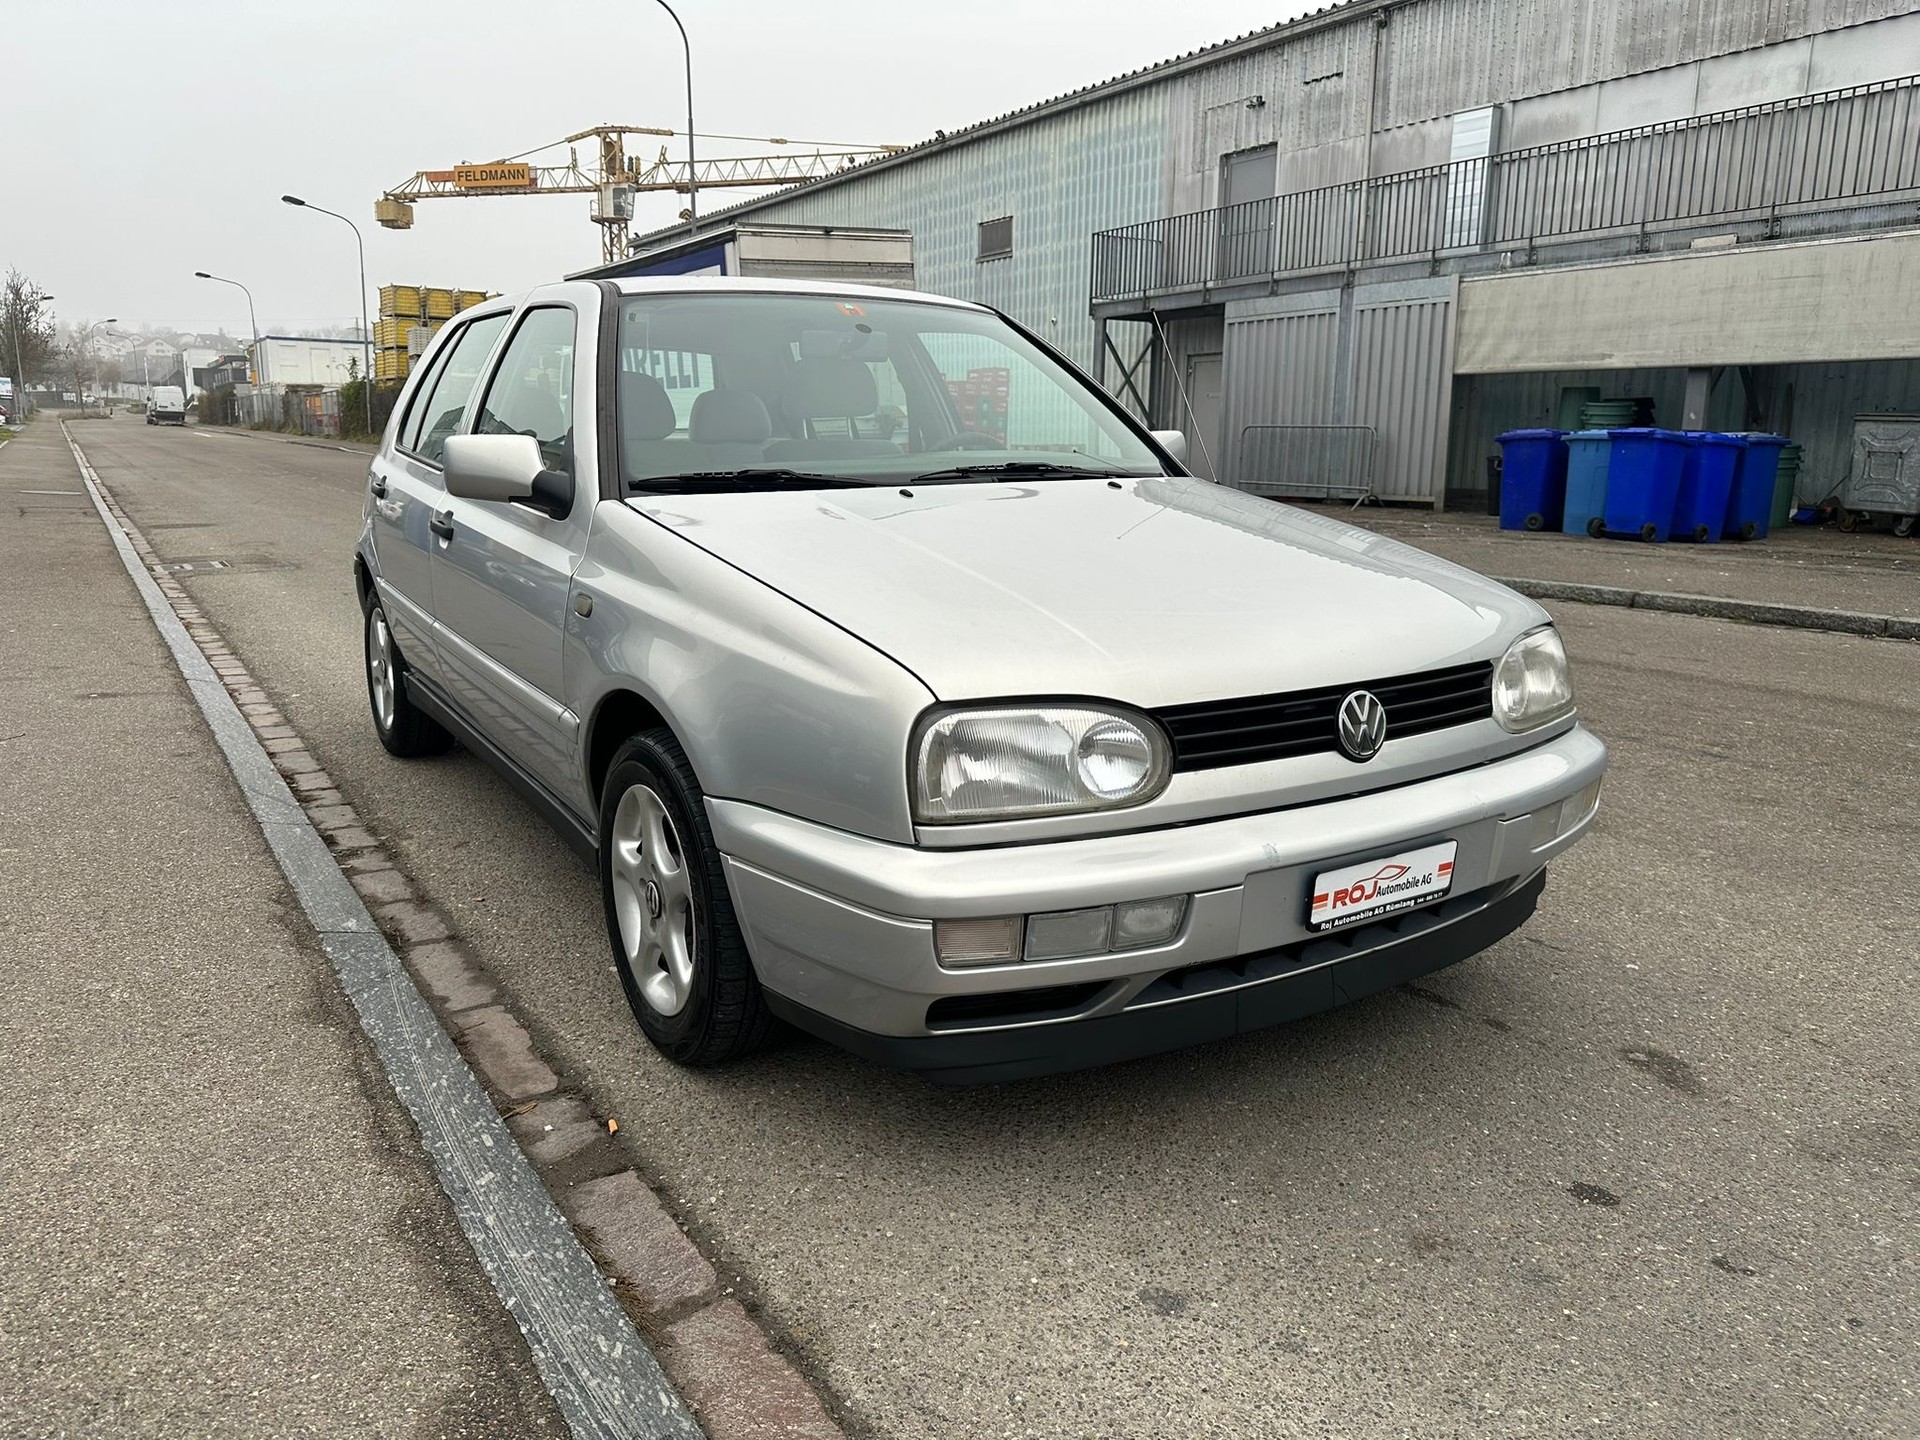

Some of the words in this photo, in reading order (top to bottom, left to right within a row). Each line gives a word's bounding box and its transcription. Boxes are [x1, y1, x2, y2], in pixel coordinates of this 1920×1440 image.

[457, 168, 525, 182] FELDMANN
[1339, 690, 1386, 757] VW
[1332, 880, 1378, 909] ROJ
[1376, 876, 1419, 898] Automobile
[1420, 873, 1432, 886] AG
[1333, 910, 1373, 927] Automobile
[1374, 906, 1384, 915] AG
